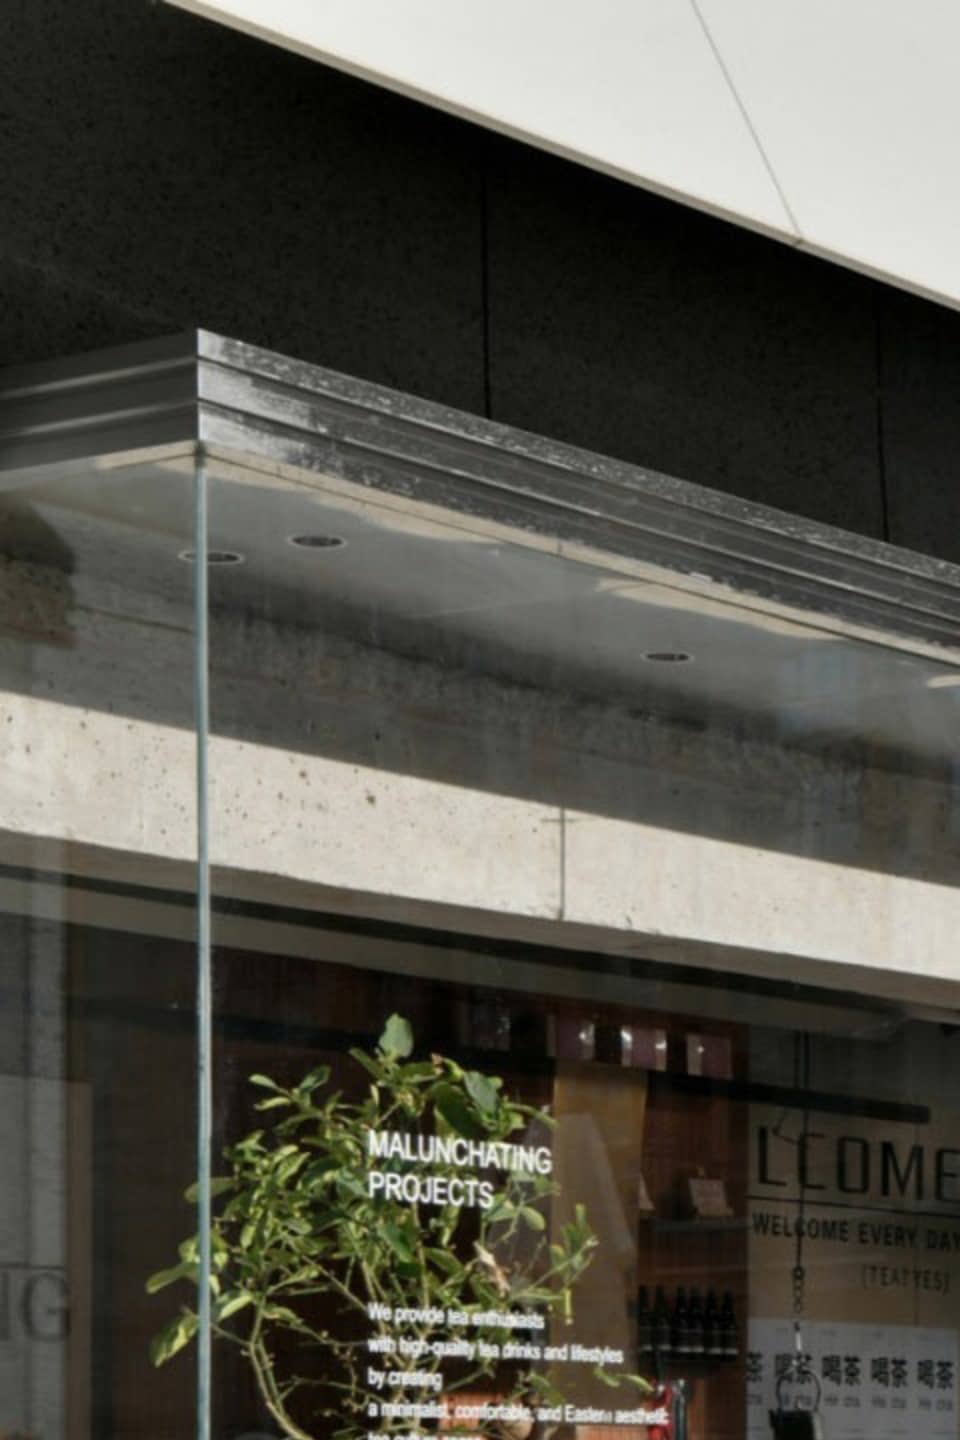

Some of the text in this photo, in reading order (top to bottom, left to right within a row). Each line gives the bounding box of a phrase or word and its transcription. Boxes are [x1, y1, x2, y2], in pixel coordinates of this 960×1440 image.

[368, 1130, 552, 1173] MALUNCHATING
[368, 1171, 495, 1208] PROJECTS
[752, 1212, 849, 1242] WELCOME
[858, 1222, 917, 1248] EVERY
[368, 1304, 545, 1329] We provide tea enthusiasts
[368, 1338, 624, 1365] with high-quality tea drinks and lifestyles
[368, 1370, 442, 1391] by creating
[368, 1404, 378, 1416] a
[455, 1403, 532, 1422] comfortable,
[537, 1406, 561, 1421] and
[565, 1407, 612, 1423] Eastern
